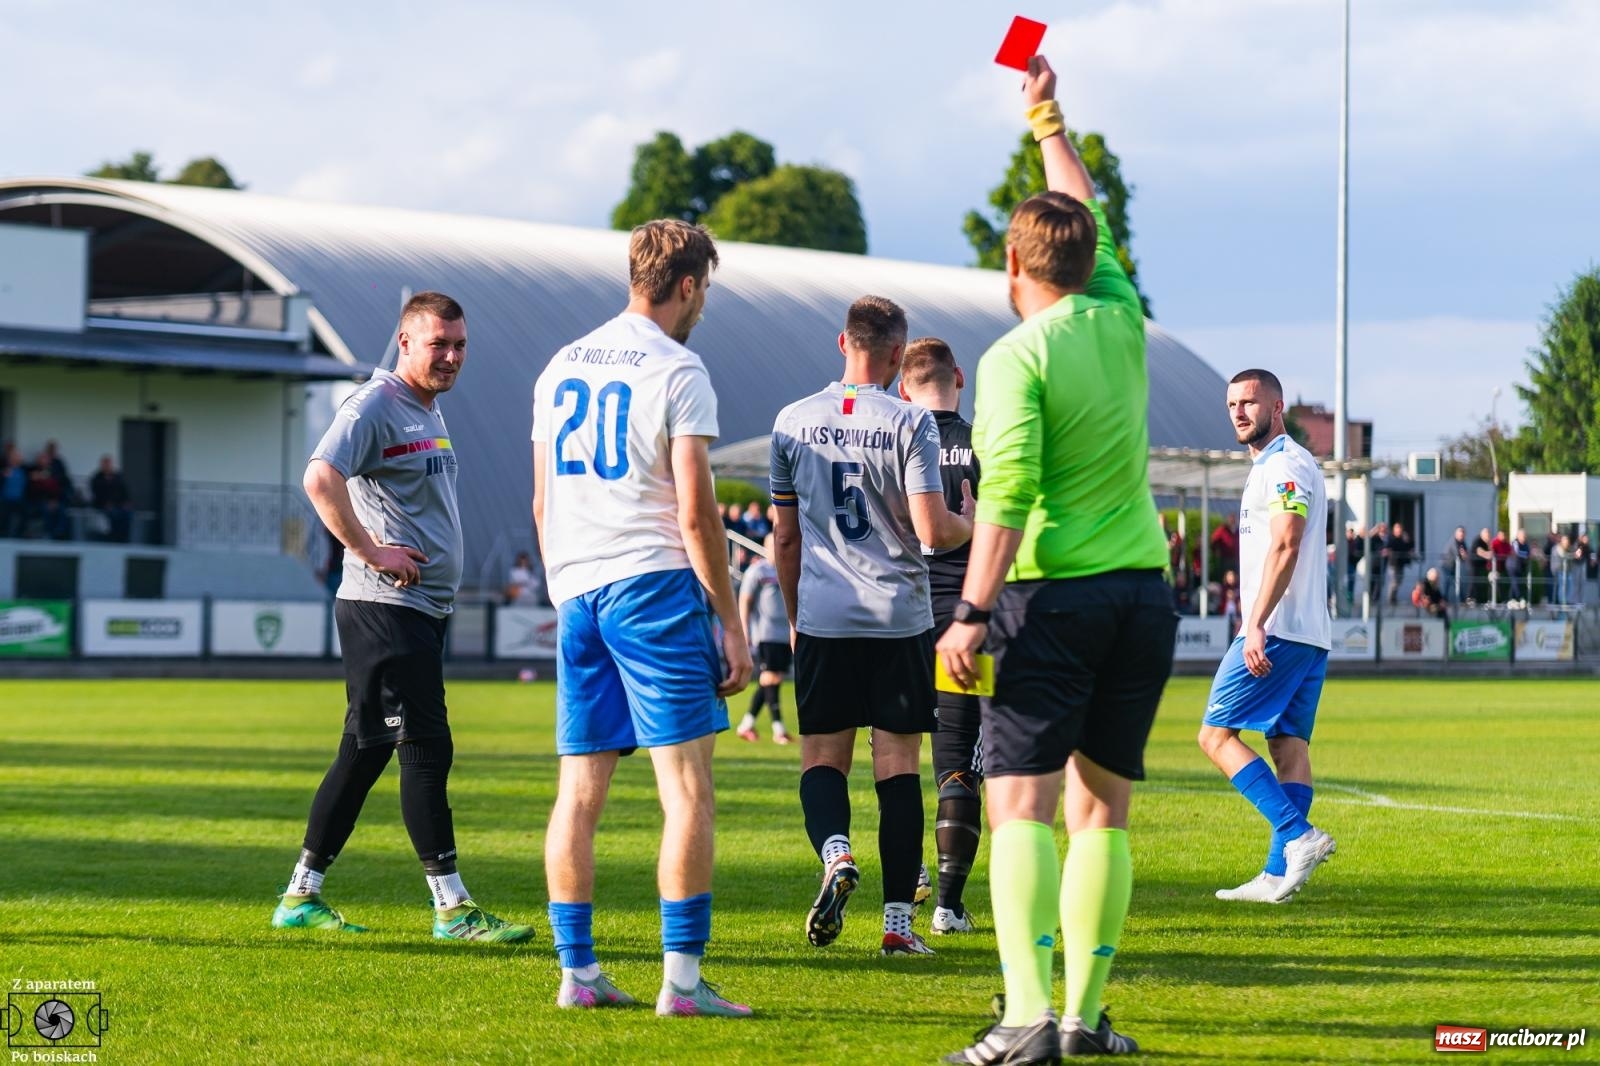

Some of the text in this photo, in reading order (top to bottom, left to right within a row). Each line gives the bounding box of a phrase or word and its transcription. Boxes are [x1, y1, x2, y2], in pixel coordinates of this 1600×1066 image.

[583, 348, 647, 367] KOLEJARZ
[554, 377, 632, 481] 20
[802, 426, 896, 451] LKS PAWŁÓW
[939, 445, 972, 466] ŁÓW
[832, 461, 873, 542] 5
